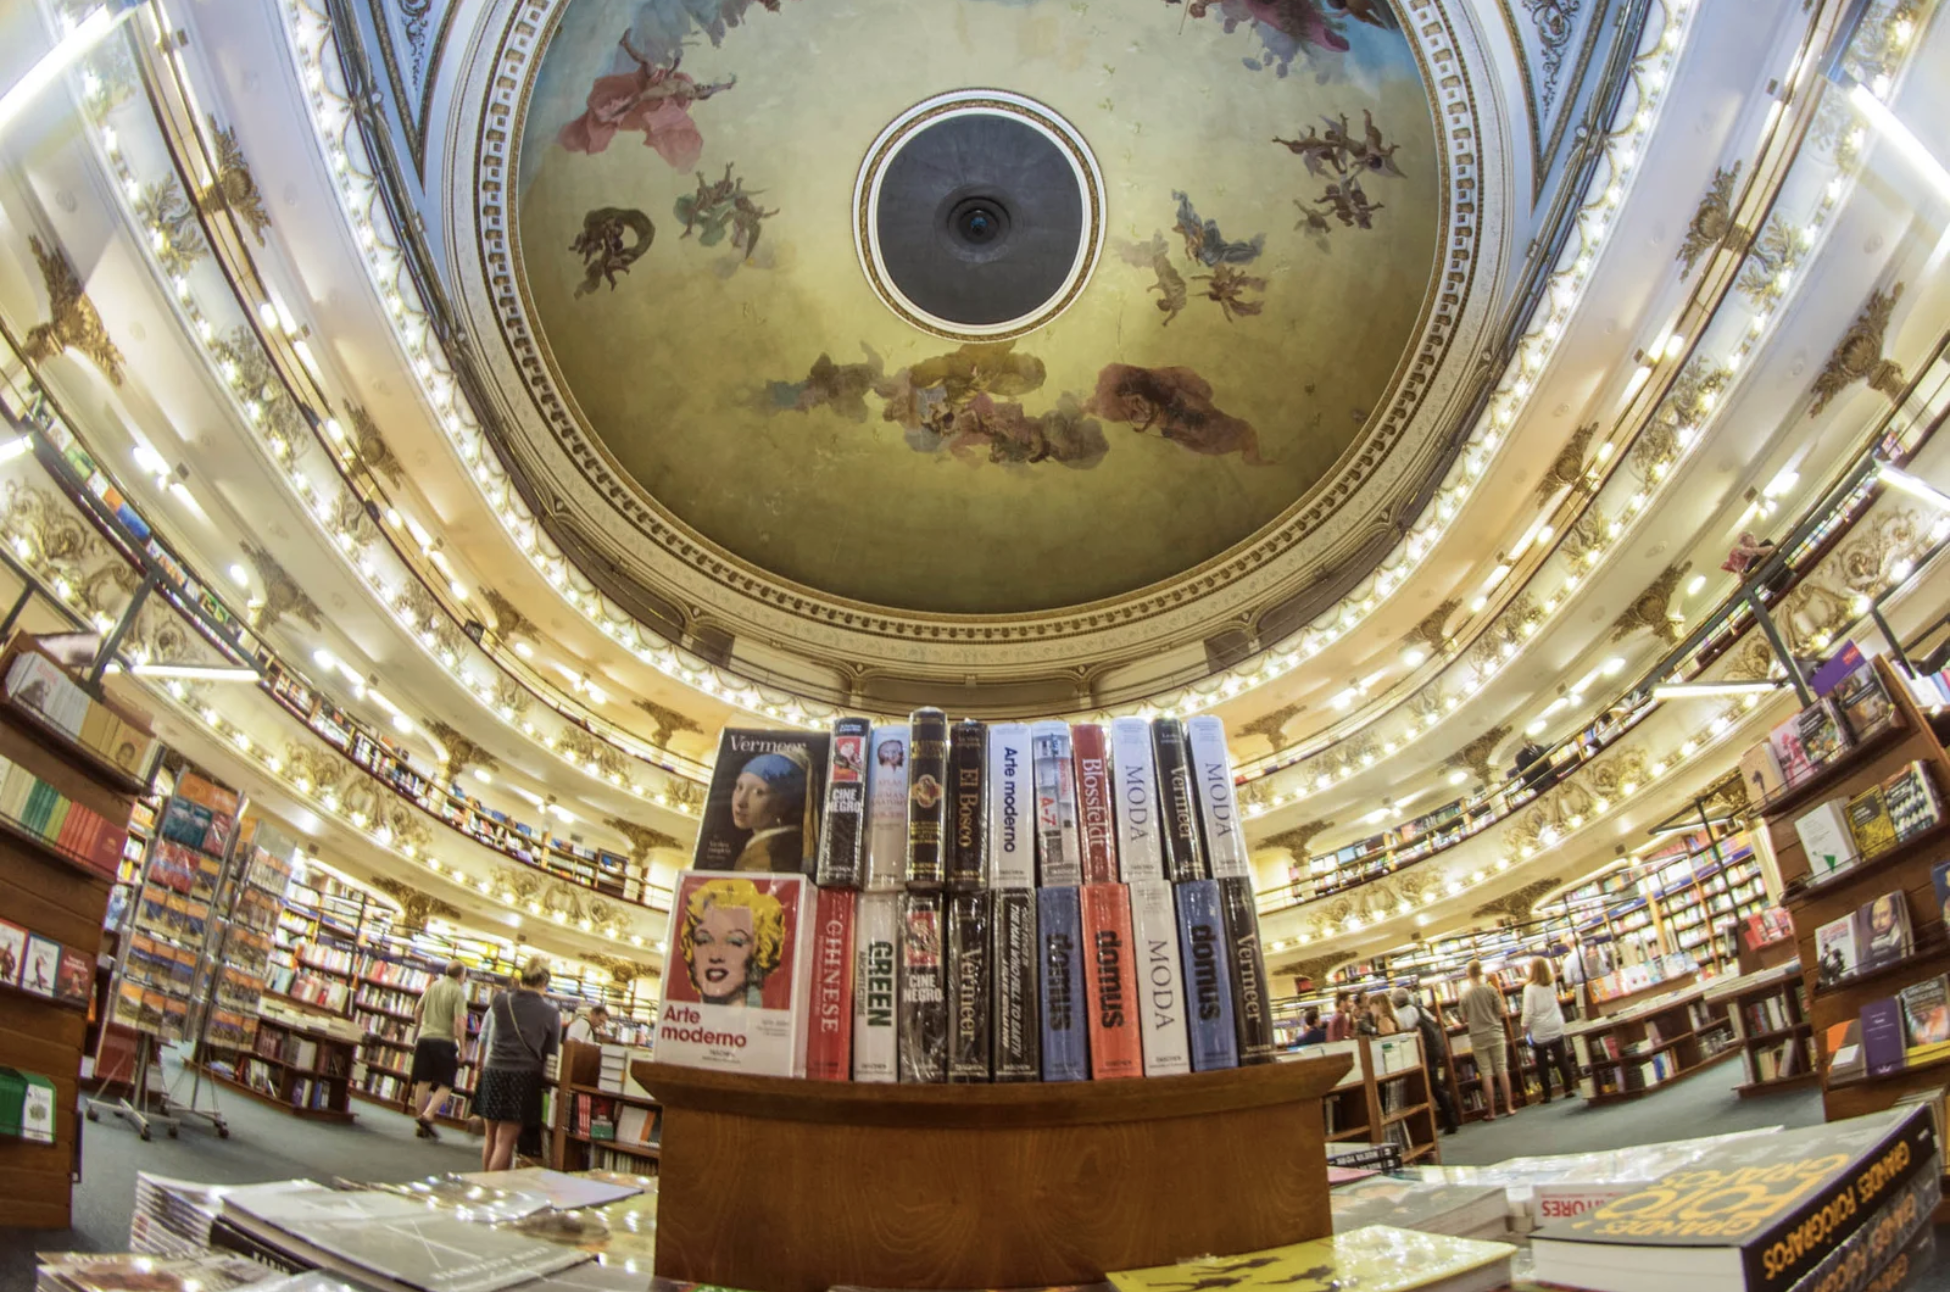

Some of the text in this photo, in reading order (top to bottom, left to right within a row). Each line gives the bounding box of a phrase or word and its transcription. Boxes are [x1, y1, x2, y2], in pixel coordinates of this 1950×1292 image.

[730, 735, 807, 752] Vermeer
[1004, 747, 1018, 777] Arte
[832, 788, 857, 800] CINE
[960, 767, 979, 787] El
[828, 801, 862, 813] NEGRO
[1003, 783, 1018, 853] moderno
[1040, 796, 1057, 827] A-Z
[1082, 758, 1107, 847] Blossfeldt
[1126, 765, 1149, 842] MODA
[1170, 765, 1191, 839] Vermeer
[1205, 763, 1232, 838] MODA
[958, 793, 979, 848] Bosco
[1010, 925, 1021, 947] MAN
[821, 920, 843, 1033] CHINESE
[909, 974, 936, 987] CINE
[1010, 949, 1021, 974] WHO
[1095, 930, 1124, 1029] domus
[1191, 924, 1221, 1021] domus
[1238, 933, 1262, 1023] Vermeer
[867, 941, 893, 1027] GREEN
[903, 988, 942, 1002] NEGRO
[960, 949, 982, 1041] Vermeer
[1010, 973, 1021, 1001] FELL
[1047, 933, 1073, 1031] domus
[1148, 940, 1175, 1030] MODA
[663, 1004, 701, 1024] Arte
[1010, 1002, 1021, 1019] TO
[661, 1026, 747, 1048] moderno
[1010, 1018, 1021, 1058] EARTH
[1646, 1154, 1850, 1190] GRAFOS
[1857, 1140, 1910, 1203] GRANDES
[1594, 1218, 1761, 1236] GRANDES
